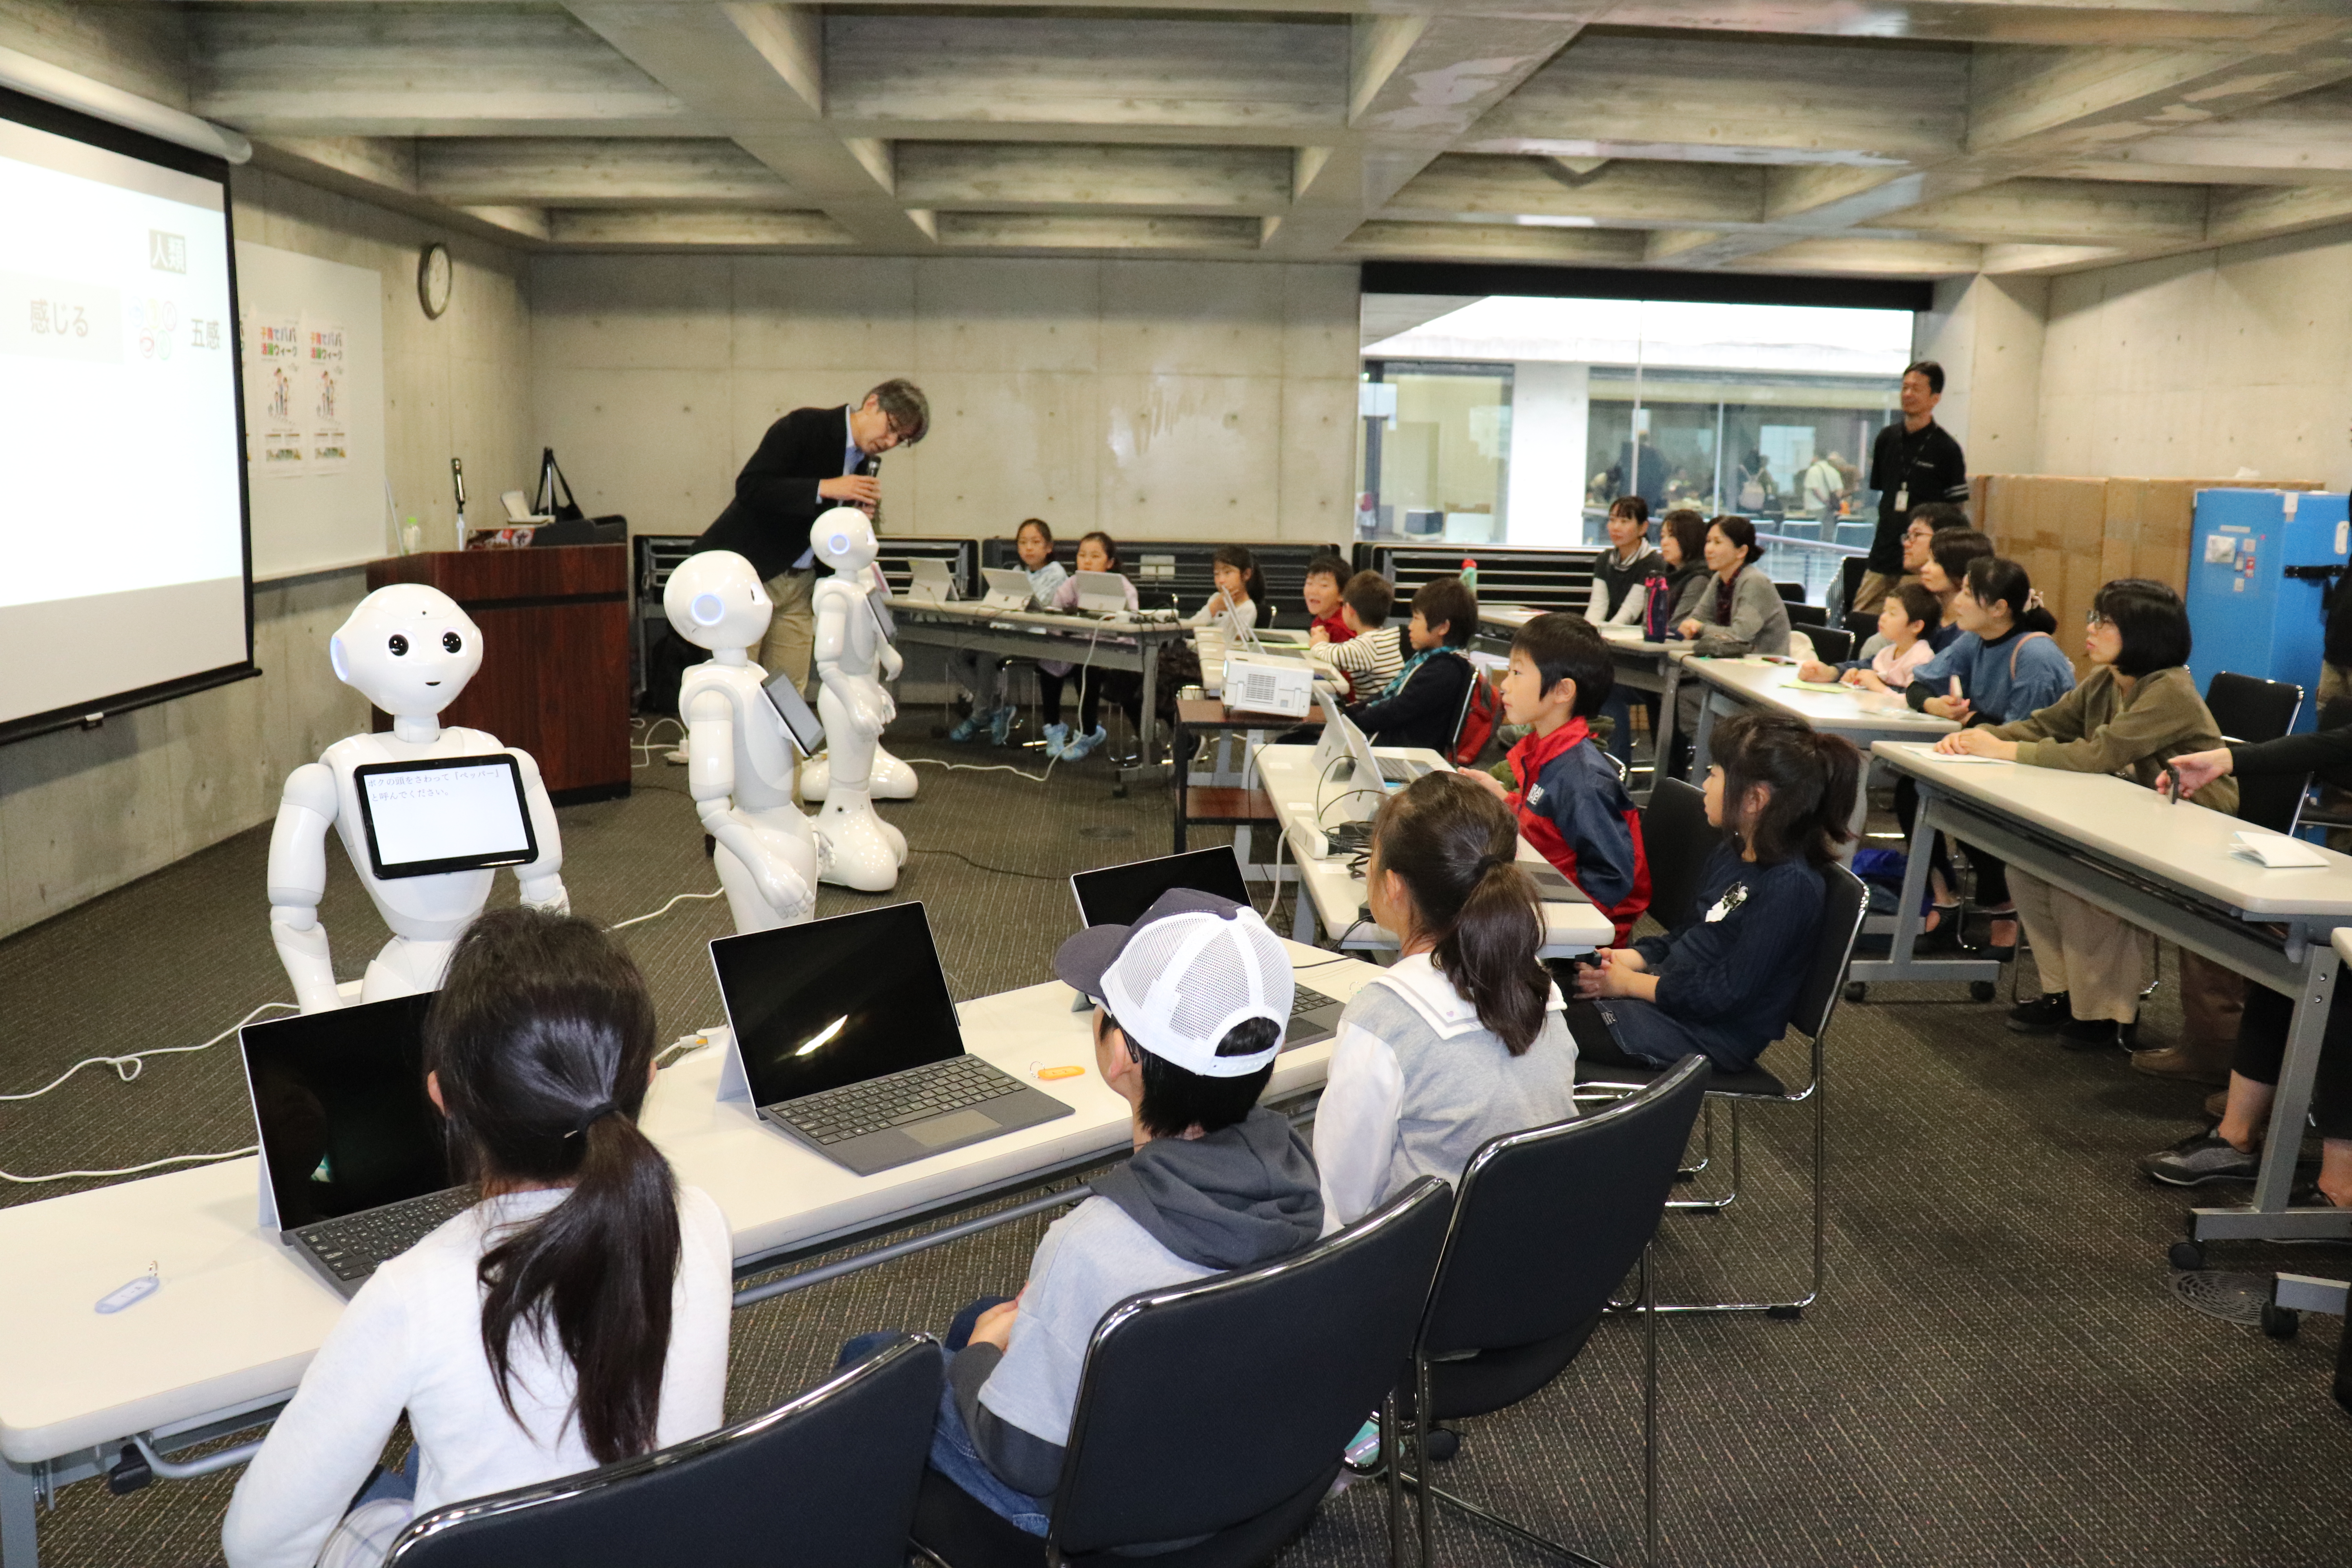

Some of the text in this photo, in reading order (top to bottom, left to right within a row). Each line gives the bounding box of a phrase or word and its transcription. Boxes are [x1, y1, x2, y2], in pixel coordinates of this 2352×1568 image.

[151, 234, 186, 273] 人類
[30, 298, 88, 337] 感じる
[191, 318, 221, 350] 五感
